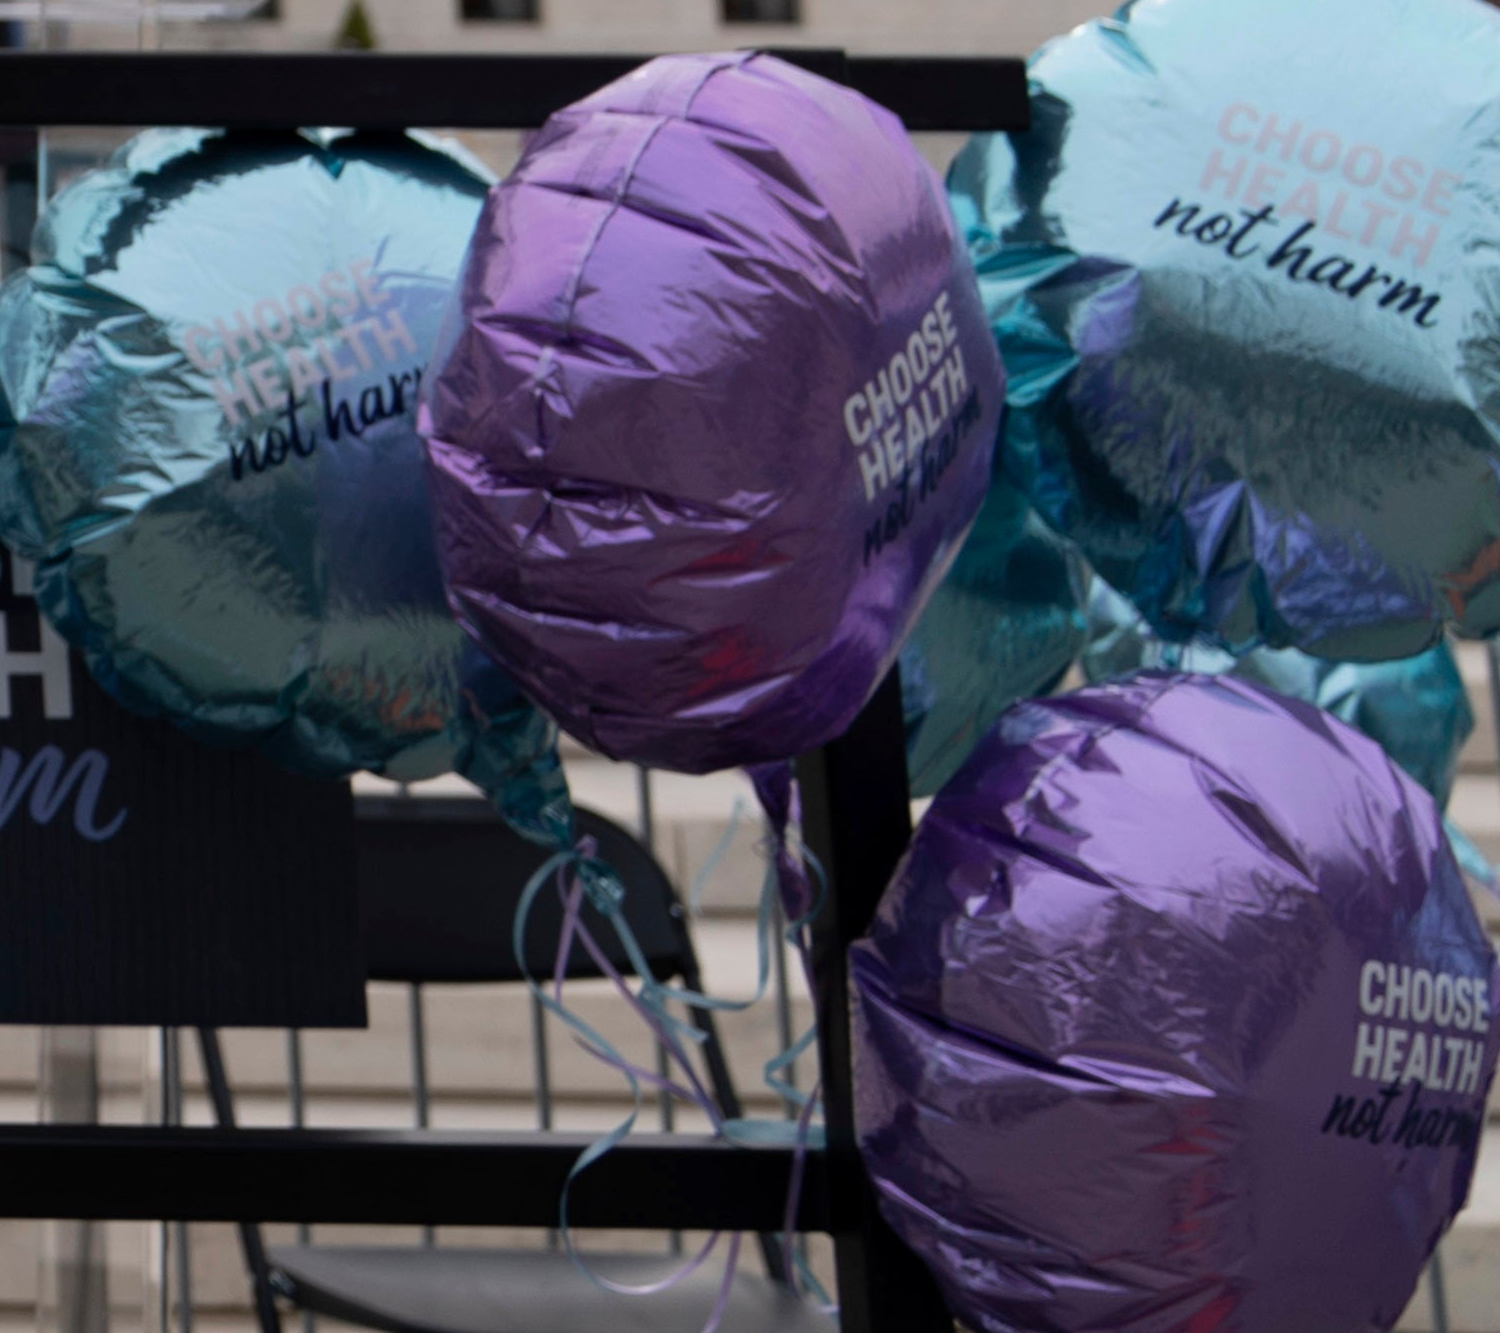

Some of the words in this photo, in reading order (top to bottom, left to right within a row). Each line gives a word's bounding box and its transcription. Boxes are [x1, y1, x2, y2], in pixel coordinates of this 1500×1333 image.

[1200, 148, 1442, 267] HEALTH
[1218, 102, 1463, 216] CHOOSE
[183, 258, 391, 372] CHOOSE
[1153, 195, 1280, 260] not
[1266, 220, 1444, 328] harm
[211, 307, 418, 426] HEALTH
[229, 386, 316, 481] not
[322, 362, 429, 441] har
[844, 290, 958, 446] CHOOSE
[858, 344, 968, 503] HEALTH
[1359, 959, 1490, 1033] CHOOSE
[1322, 1076, 1403, 1146] not
[1352, 1022, 1484, 1094] HEALTH
